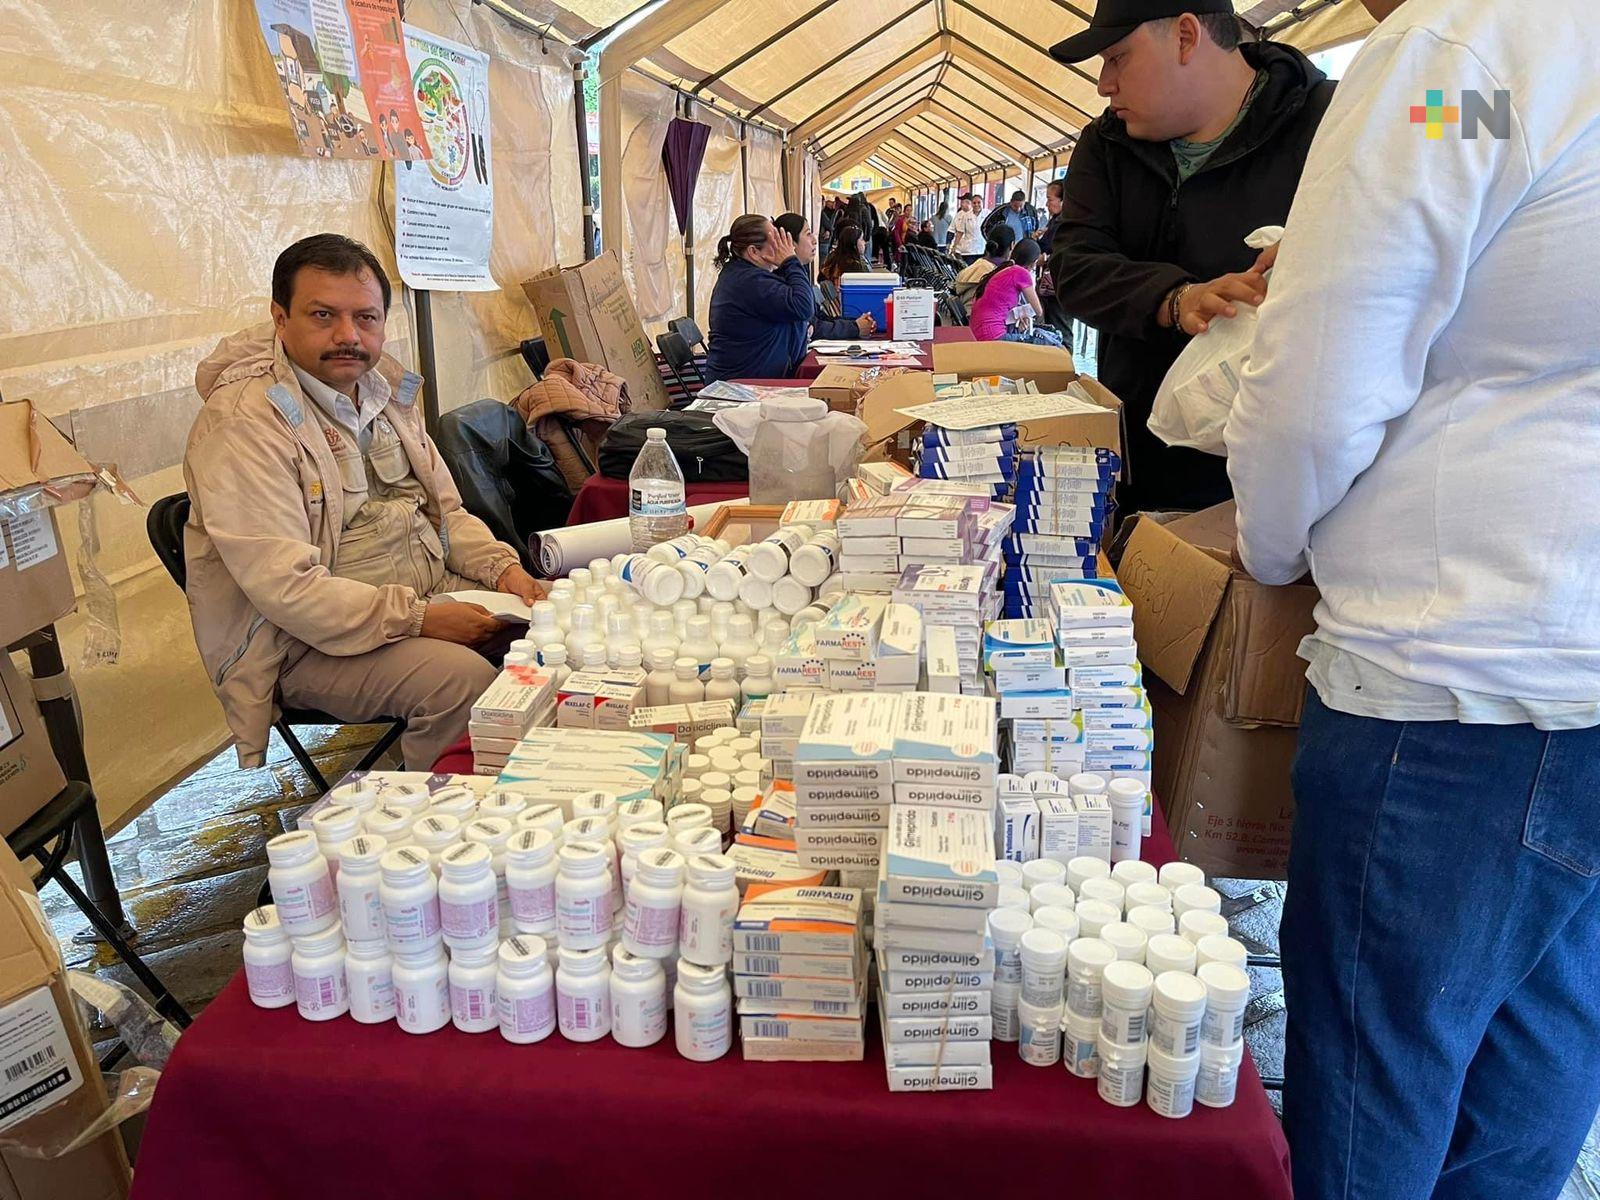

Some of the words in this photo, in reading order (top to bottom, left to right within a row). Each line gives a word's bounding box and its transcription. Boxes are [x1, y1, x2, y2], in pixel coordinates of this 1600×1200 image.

[816, 639, 862, 649] FARMAREST
[777, 666, 822, 675] FARMAREST
[831, 669, 876, 678] FARMAREST
[806, 767, 879, 780] Glimepirida
[906, 767, 981, 781] Glimepirida
[808, 789, 880, 801] Glimepirida
[908, 790, 982, 804] Glimepirida
[810, 811, 881, 824] Glimepirida
[1207, 816, 1224, 827] Eje
[904, 809, 917, 849] Glimepirida
[1204, 829, 1222, 840] Km
[808, 833, 878, 846] Glimepirida
[810, 855, 880, 868] Glimepirida
[735, 865, 776, 879] DIRPAS
[796, 889, 855, 902] DIRPASID
[902, 884, 985, 902] Glimepirida
[902, 953, 980, 967] Glimepirida
